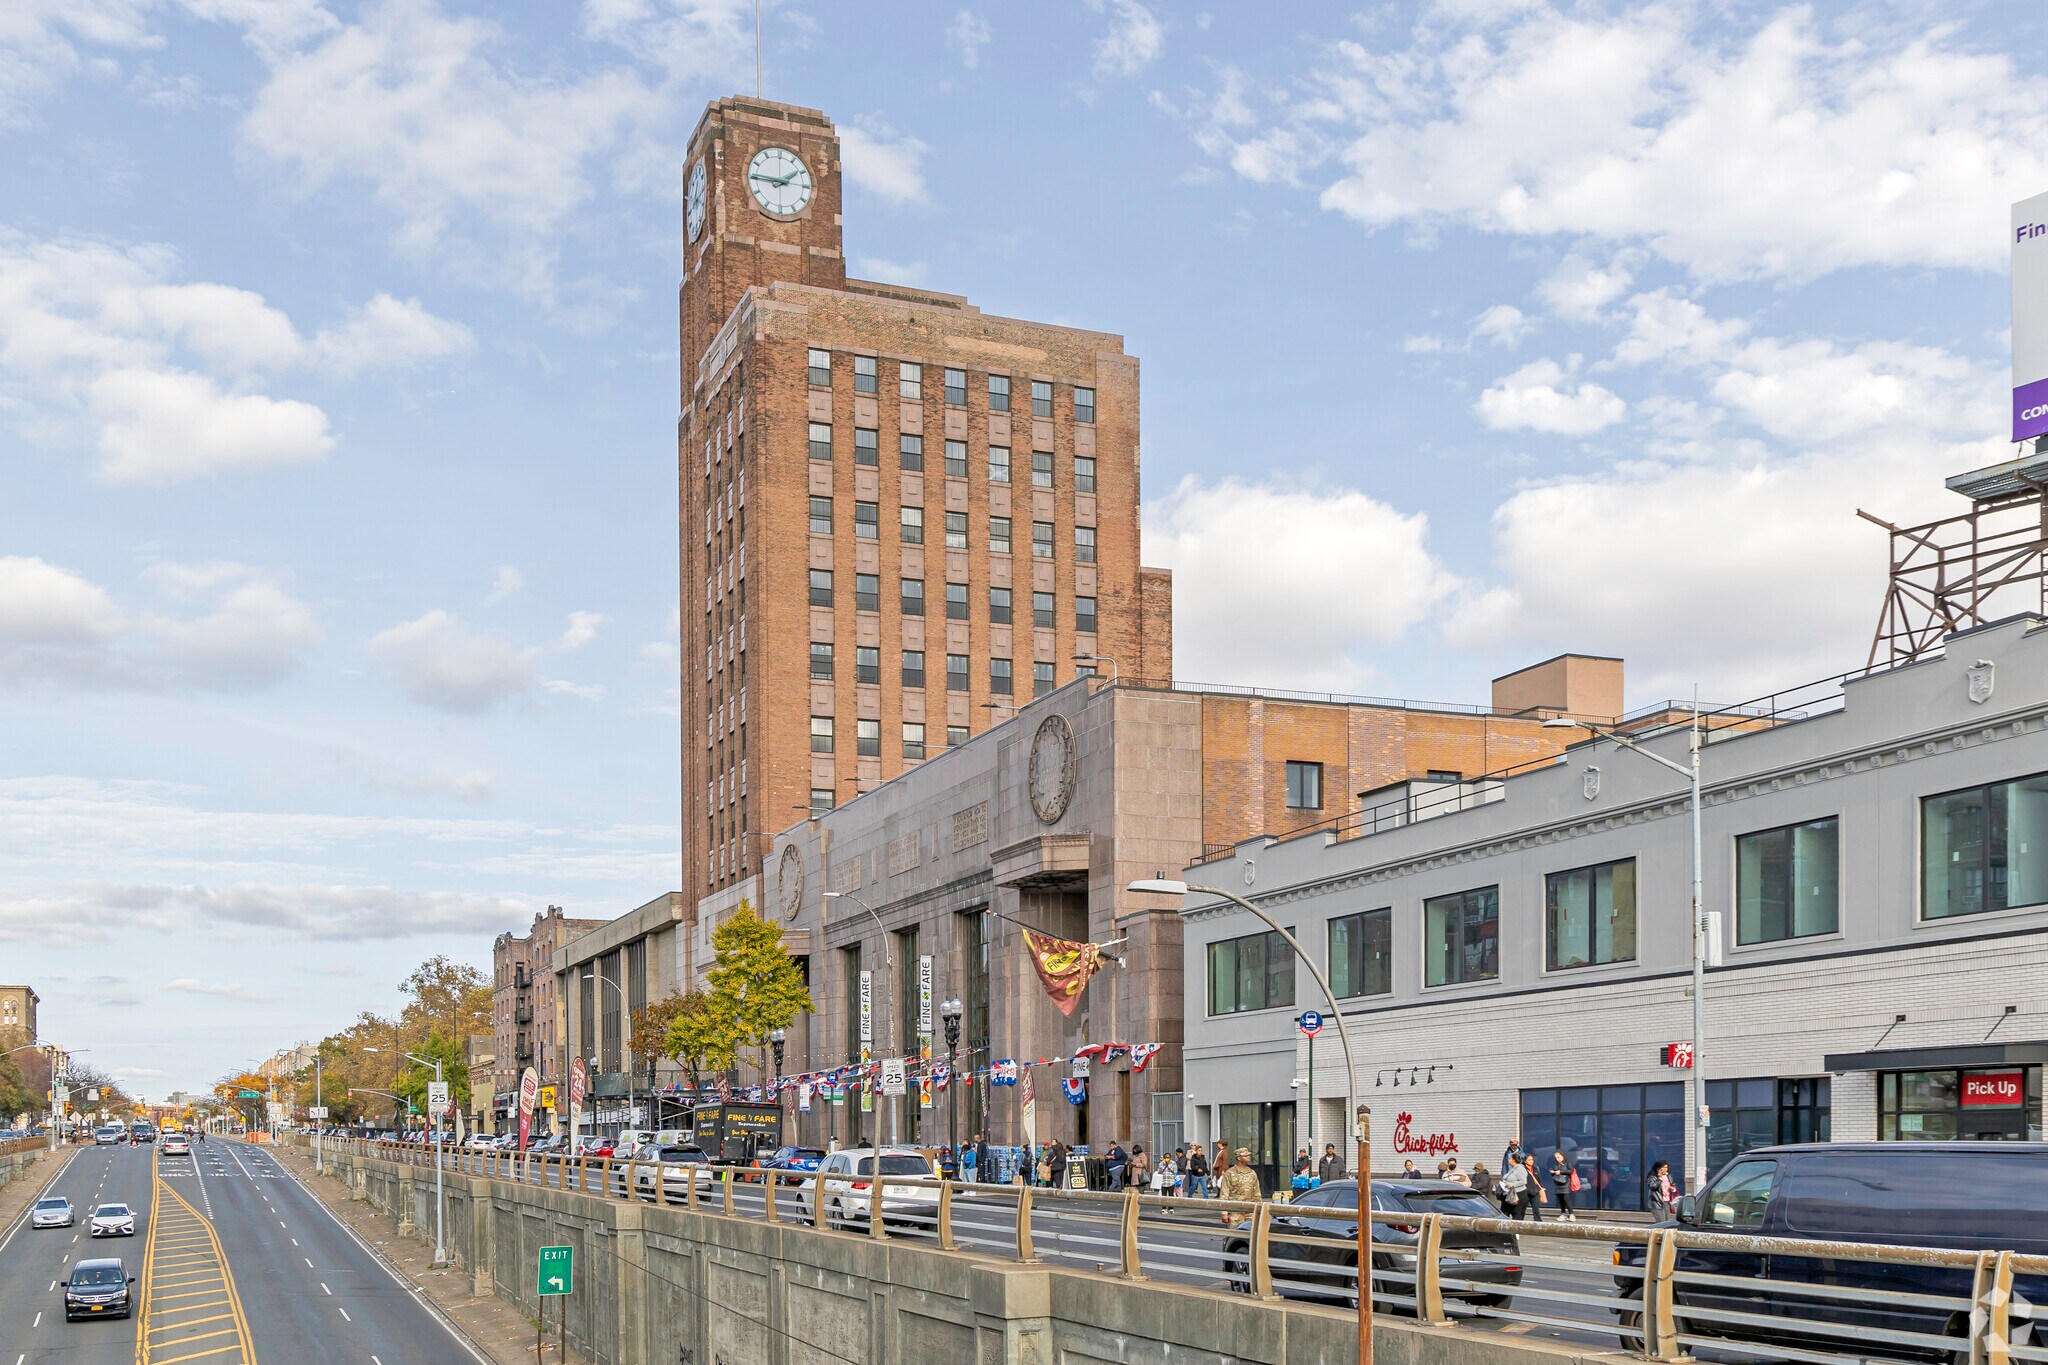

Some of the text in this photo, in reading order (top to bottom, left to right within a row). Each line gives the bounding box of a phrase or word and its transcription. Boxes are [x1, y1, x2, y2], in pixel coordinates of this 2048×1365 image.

[2016, 223, 2048, 243] Fin
[922, 962, 931, 1025] FINE FARE
[862, 977, 870, 1035] FINE FARE
[1074, 1062, 1085, 1071] FINE
[886, 1074, 903, 1083] 25
[1967, 1080, 2017, 1097] Pick Up
[431, 1094, 446, 1102] 25
[754, 1115, 777, 1123] FARE
[1394, 1119, 1459, 1157] Chick-fil-A
[544, 1250, 568, 1260] EXIT
